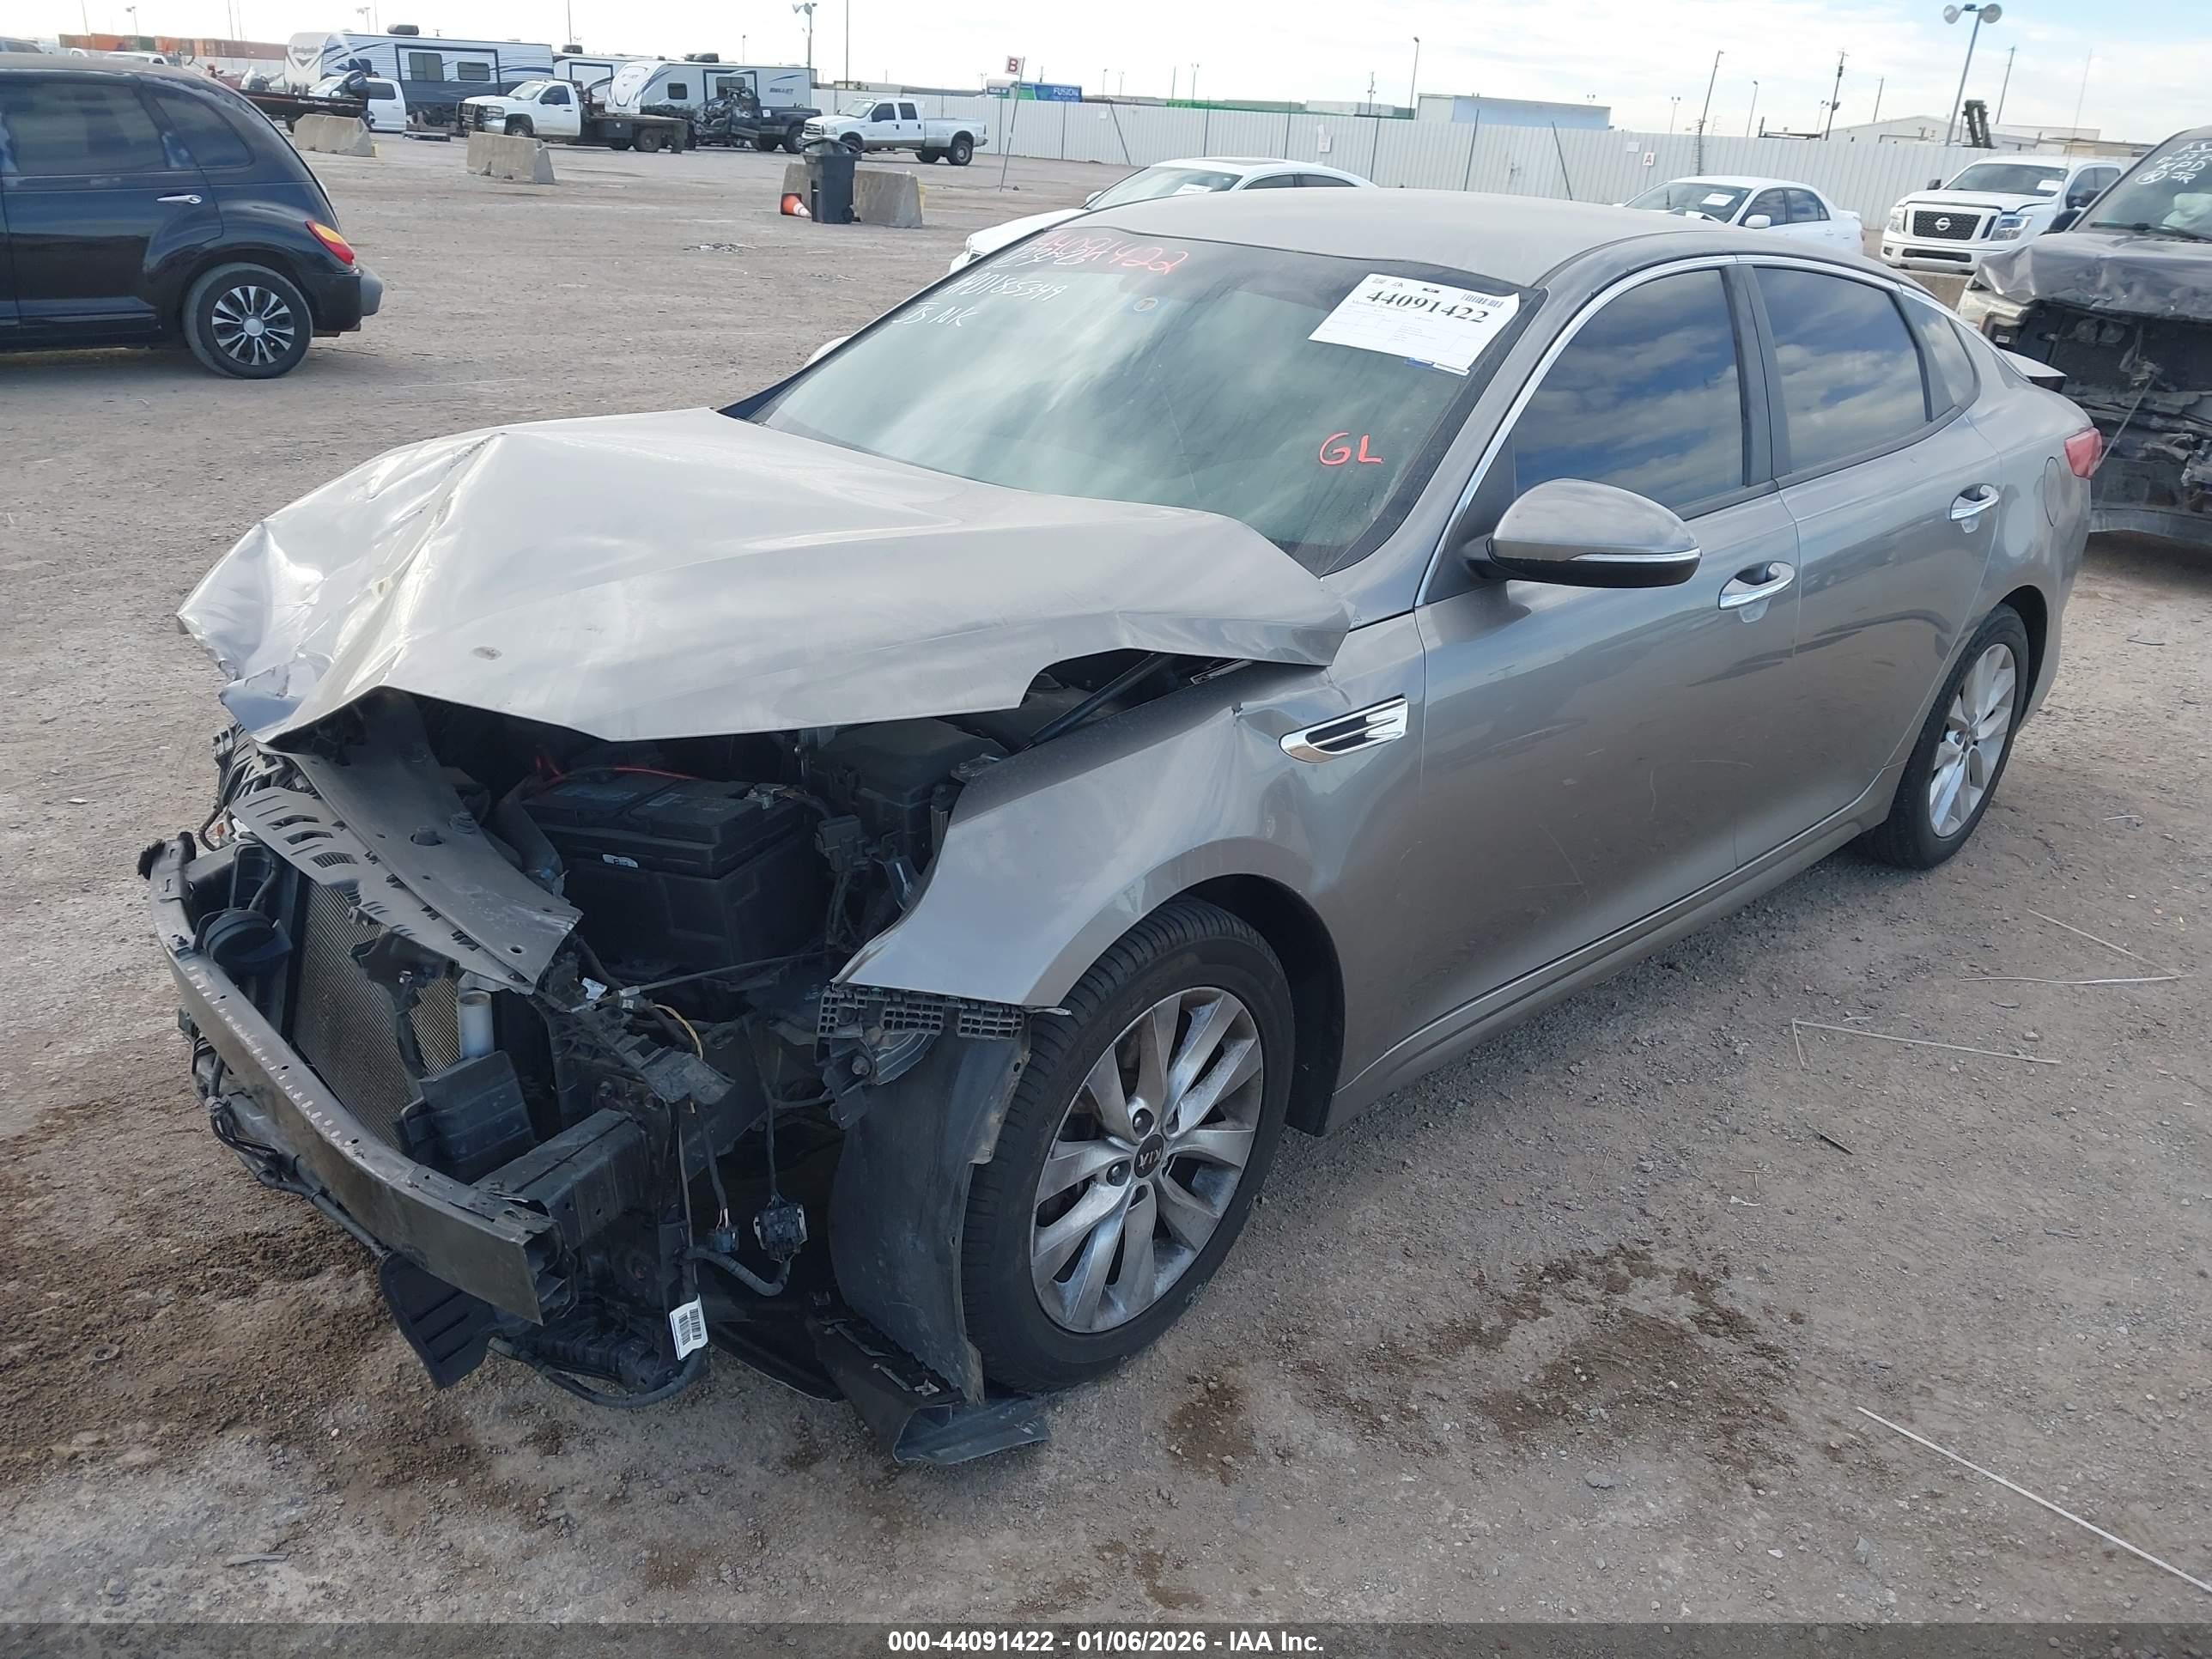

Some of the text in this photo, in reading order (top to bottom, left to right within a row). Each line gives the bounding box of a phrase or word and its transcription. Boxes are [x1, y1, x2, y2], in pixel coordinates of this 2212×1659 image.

[1007, 58, 1018, 73] B
[1053, 87, 1079, 97] FUSION
[1644, 155, 1653, 165] A
[1366, 290, 1490, 324] 44091422
[1319, 432, 1384, 465] GL
[1139, 1147, 1163, 1170] KIA
